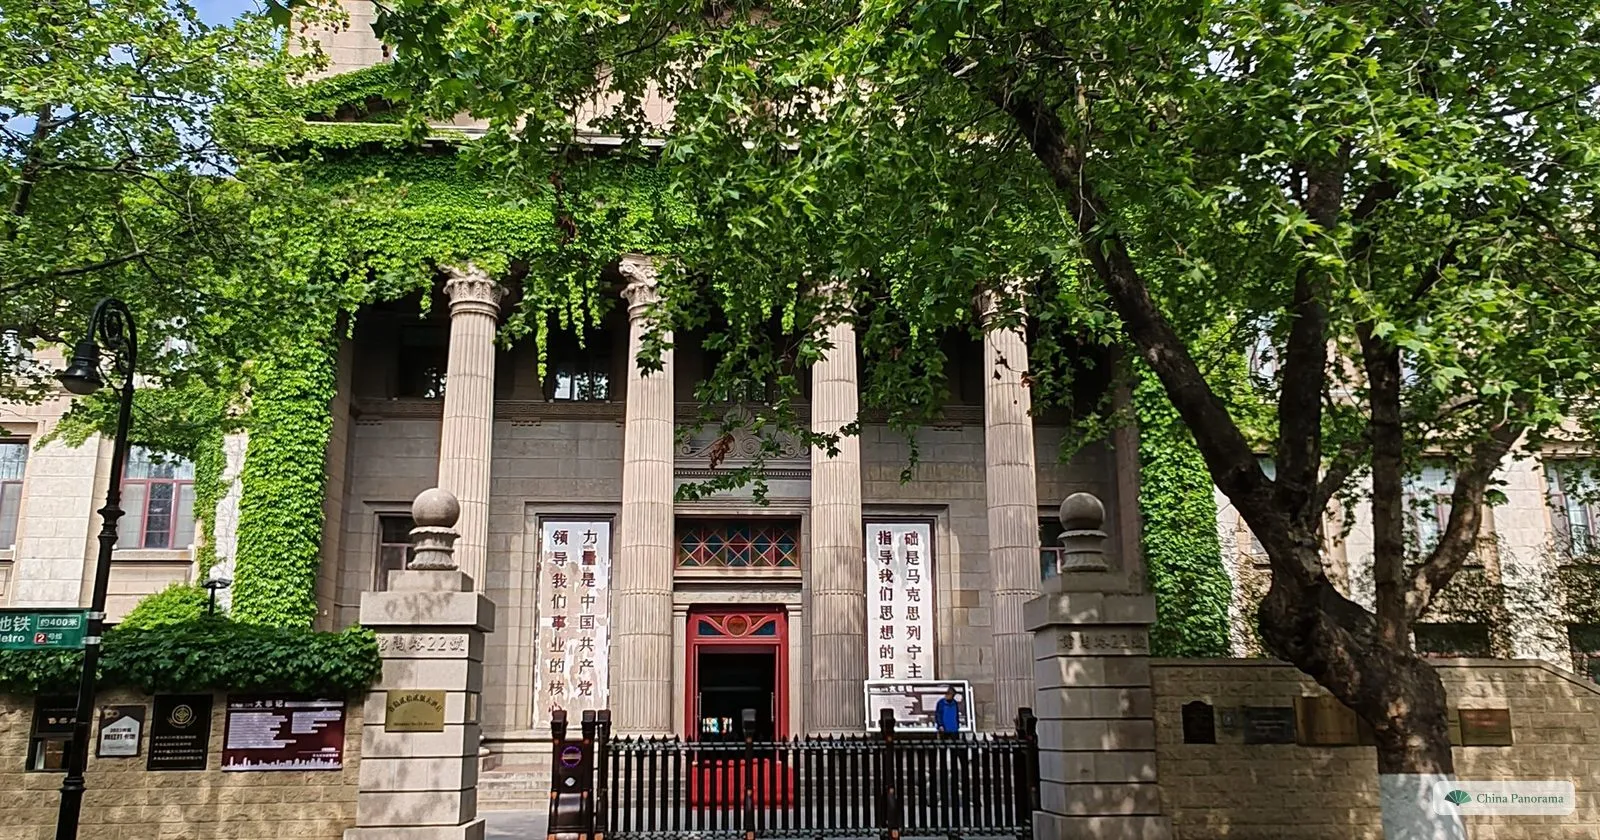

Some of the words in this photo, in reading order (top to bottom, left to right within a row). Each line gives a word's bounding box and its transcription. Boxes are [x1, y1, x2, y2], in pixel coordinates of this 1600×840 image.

[0, 615, 31, 632] 地铁
[0, 633, 25, 643] etro
[40, 618, 78, 627] 约400米
[577, 530, 597, 697] 力量是中国共产党
[878, 531, 894, 679] 指导我们思想的理
[904, 531, 922, 679] 础是马克思列宁主
